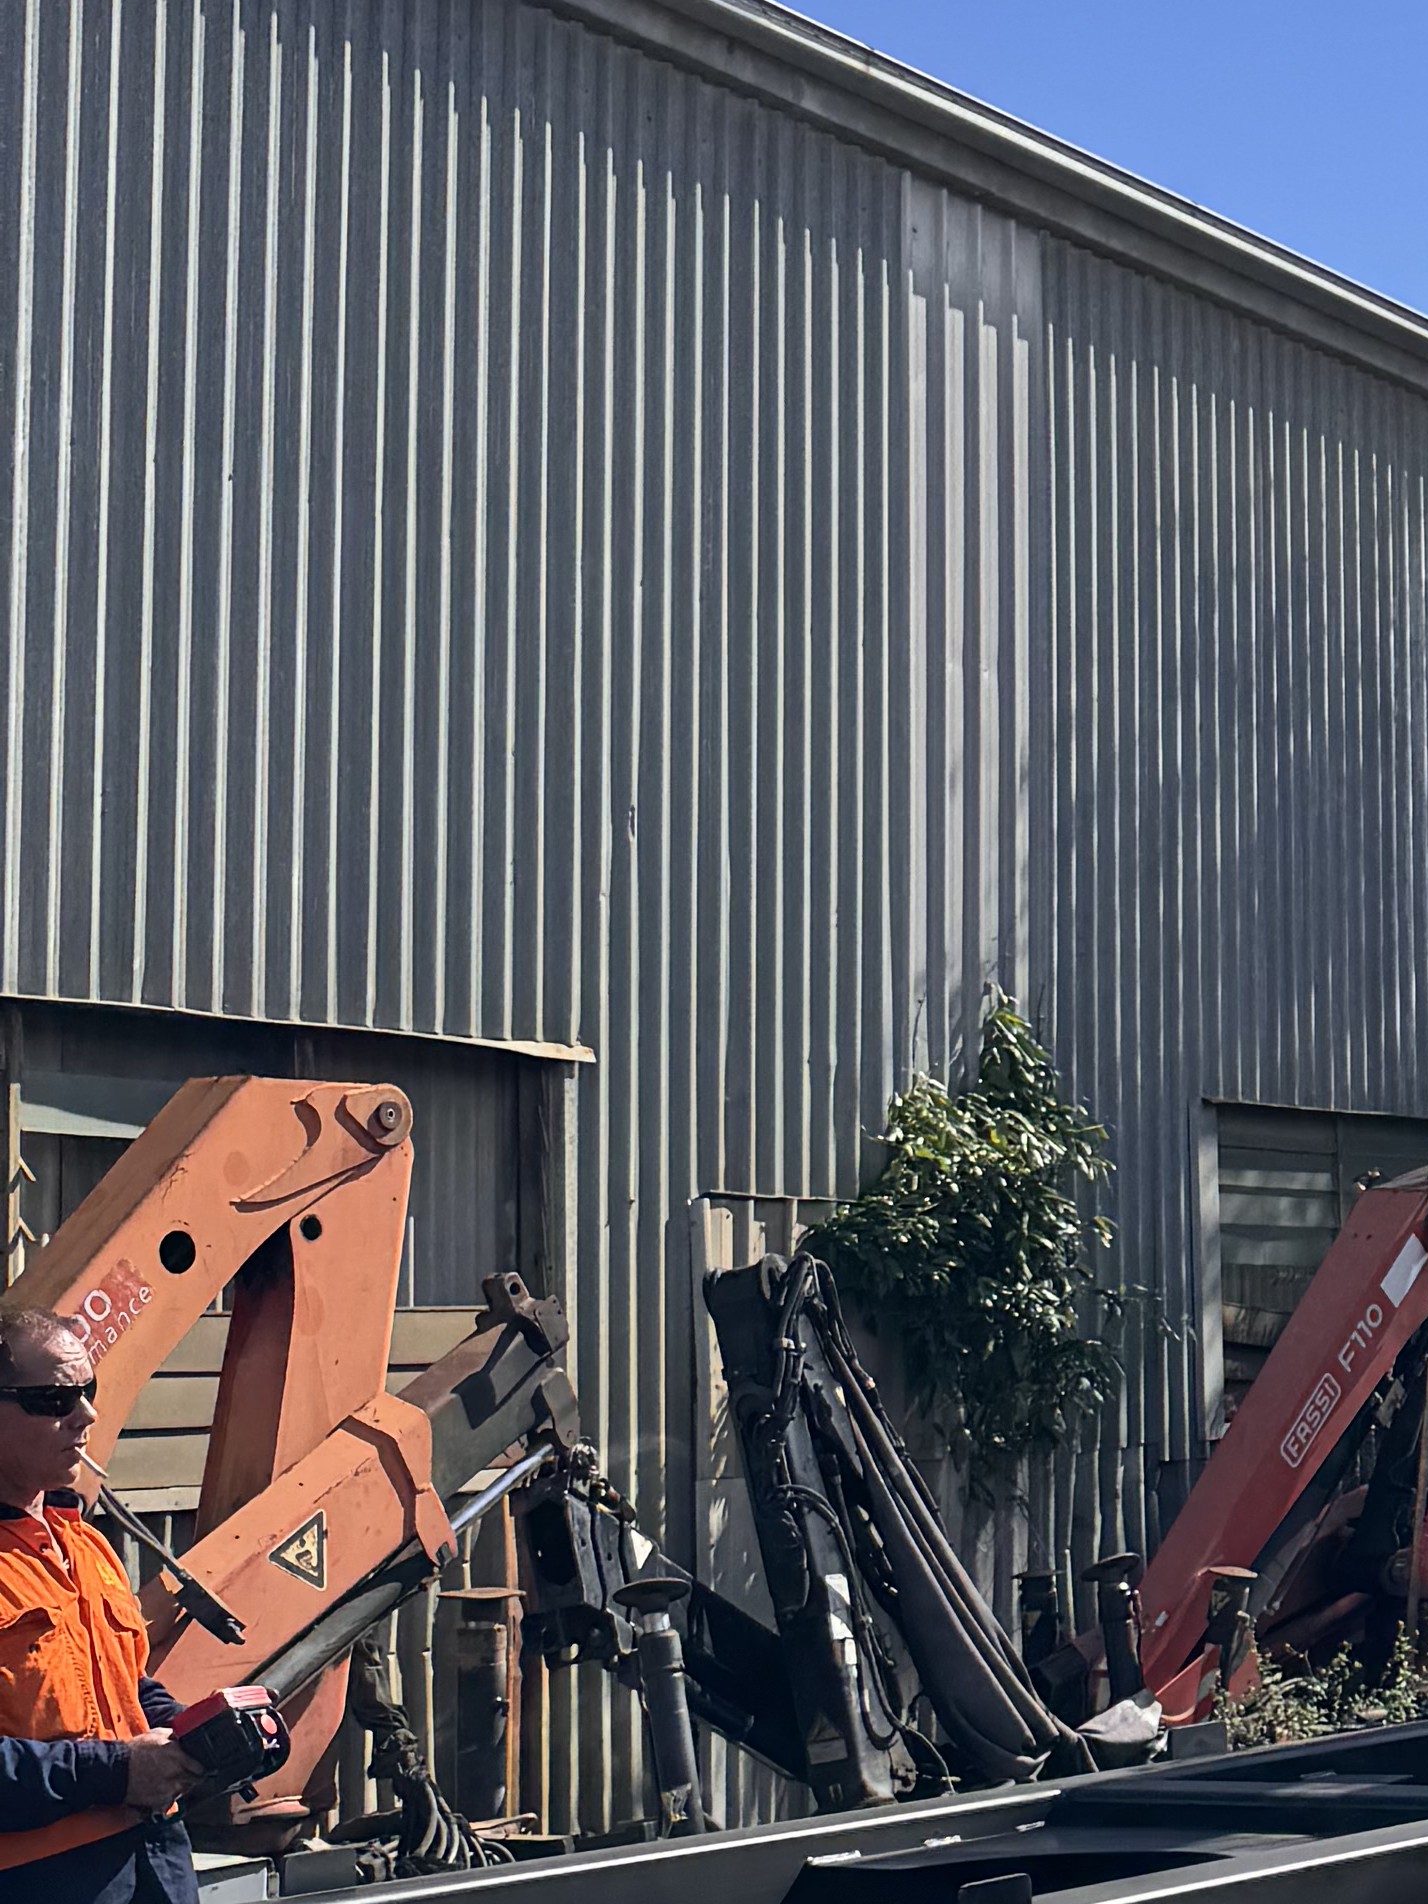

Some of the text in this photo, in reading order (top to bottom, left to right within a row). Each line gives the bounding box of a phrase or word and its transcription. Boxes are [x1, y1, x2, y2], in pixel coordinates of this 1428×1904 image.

[87, 1285, 153, 1366] mance
[1285, 1303, 1384, 1459] FASSI F110
